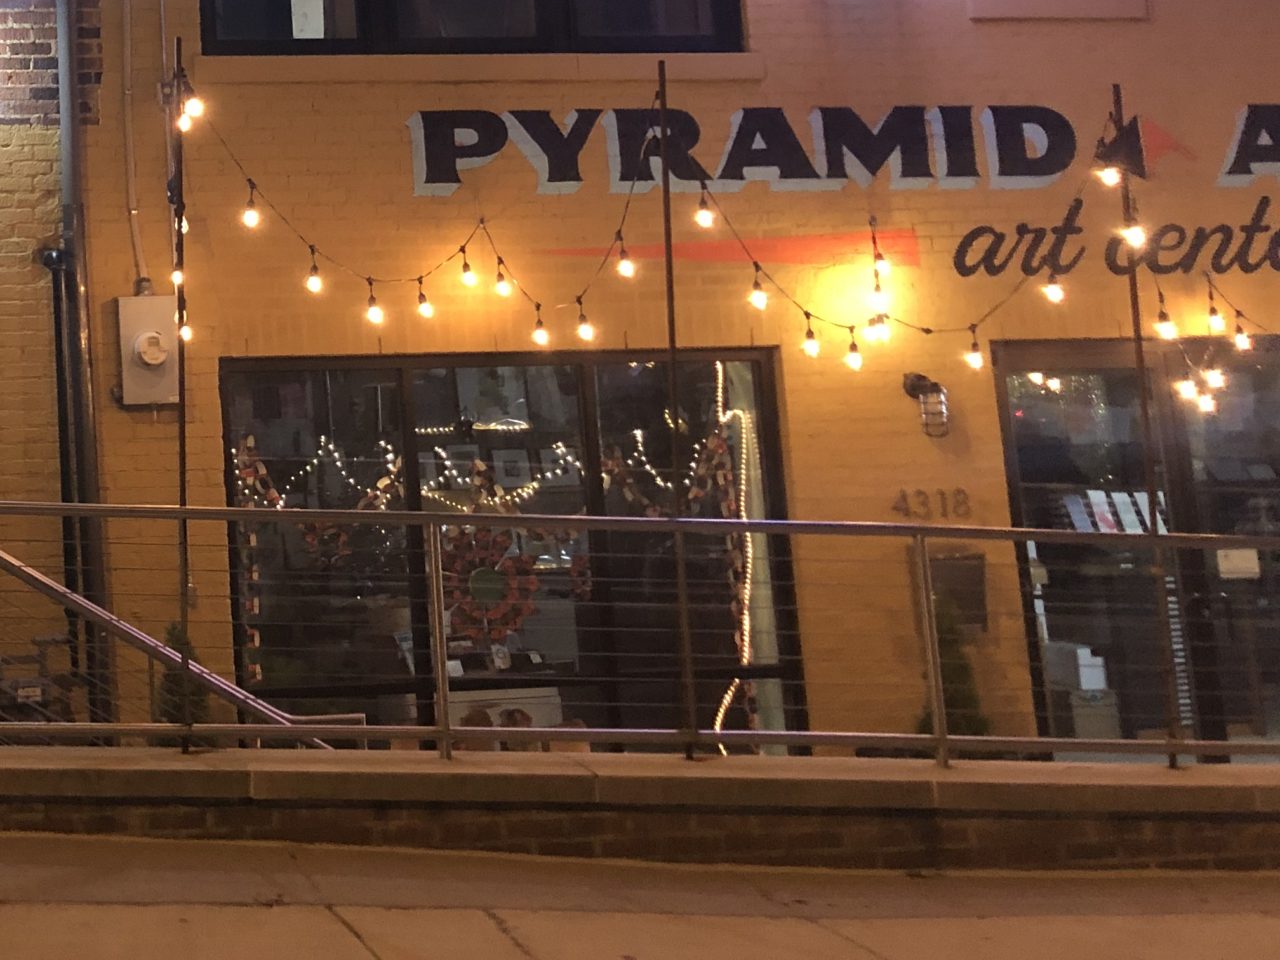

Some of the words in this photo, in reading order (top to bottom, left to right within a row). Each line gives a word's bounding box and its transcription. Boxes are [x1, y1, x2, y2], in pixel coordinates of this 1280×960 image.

[405, 105, 1077, 196] PYRAMID
[953, 198, 1086, 277] art
[891, 487, 972, 519] 4318
